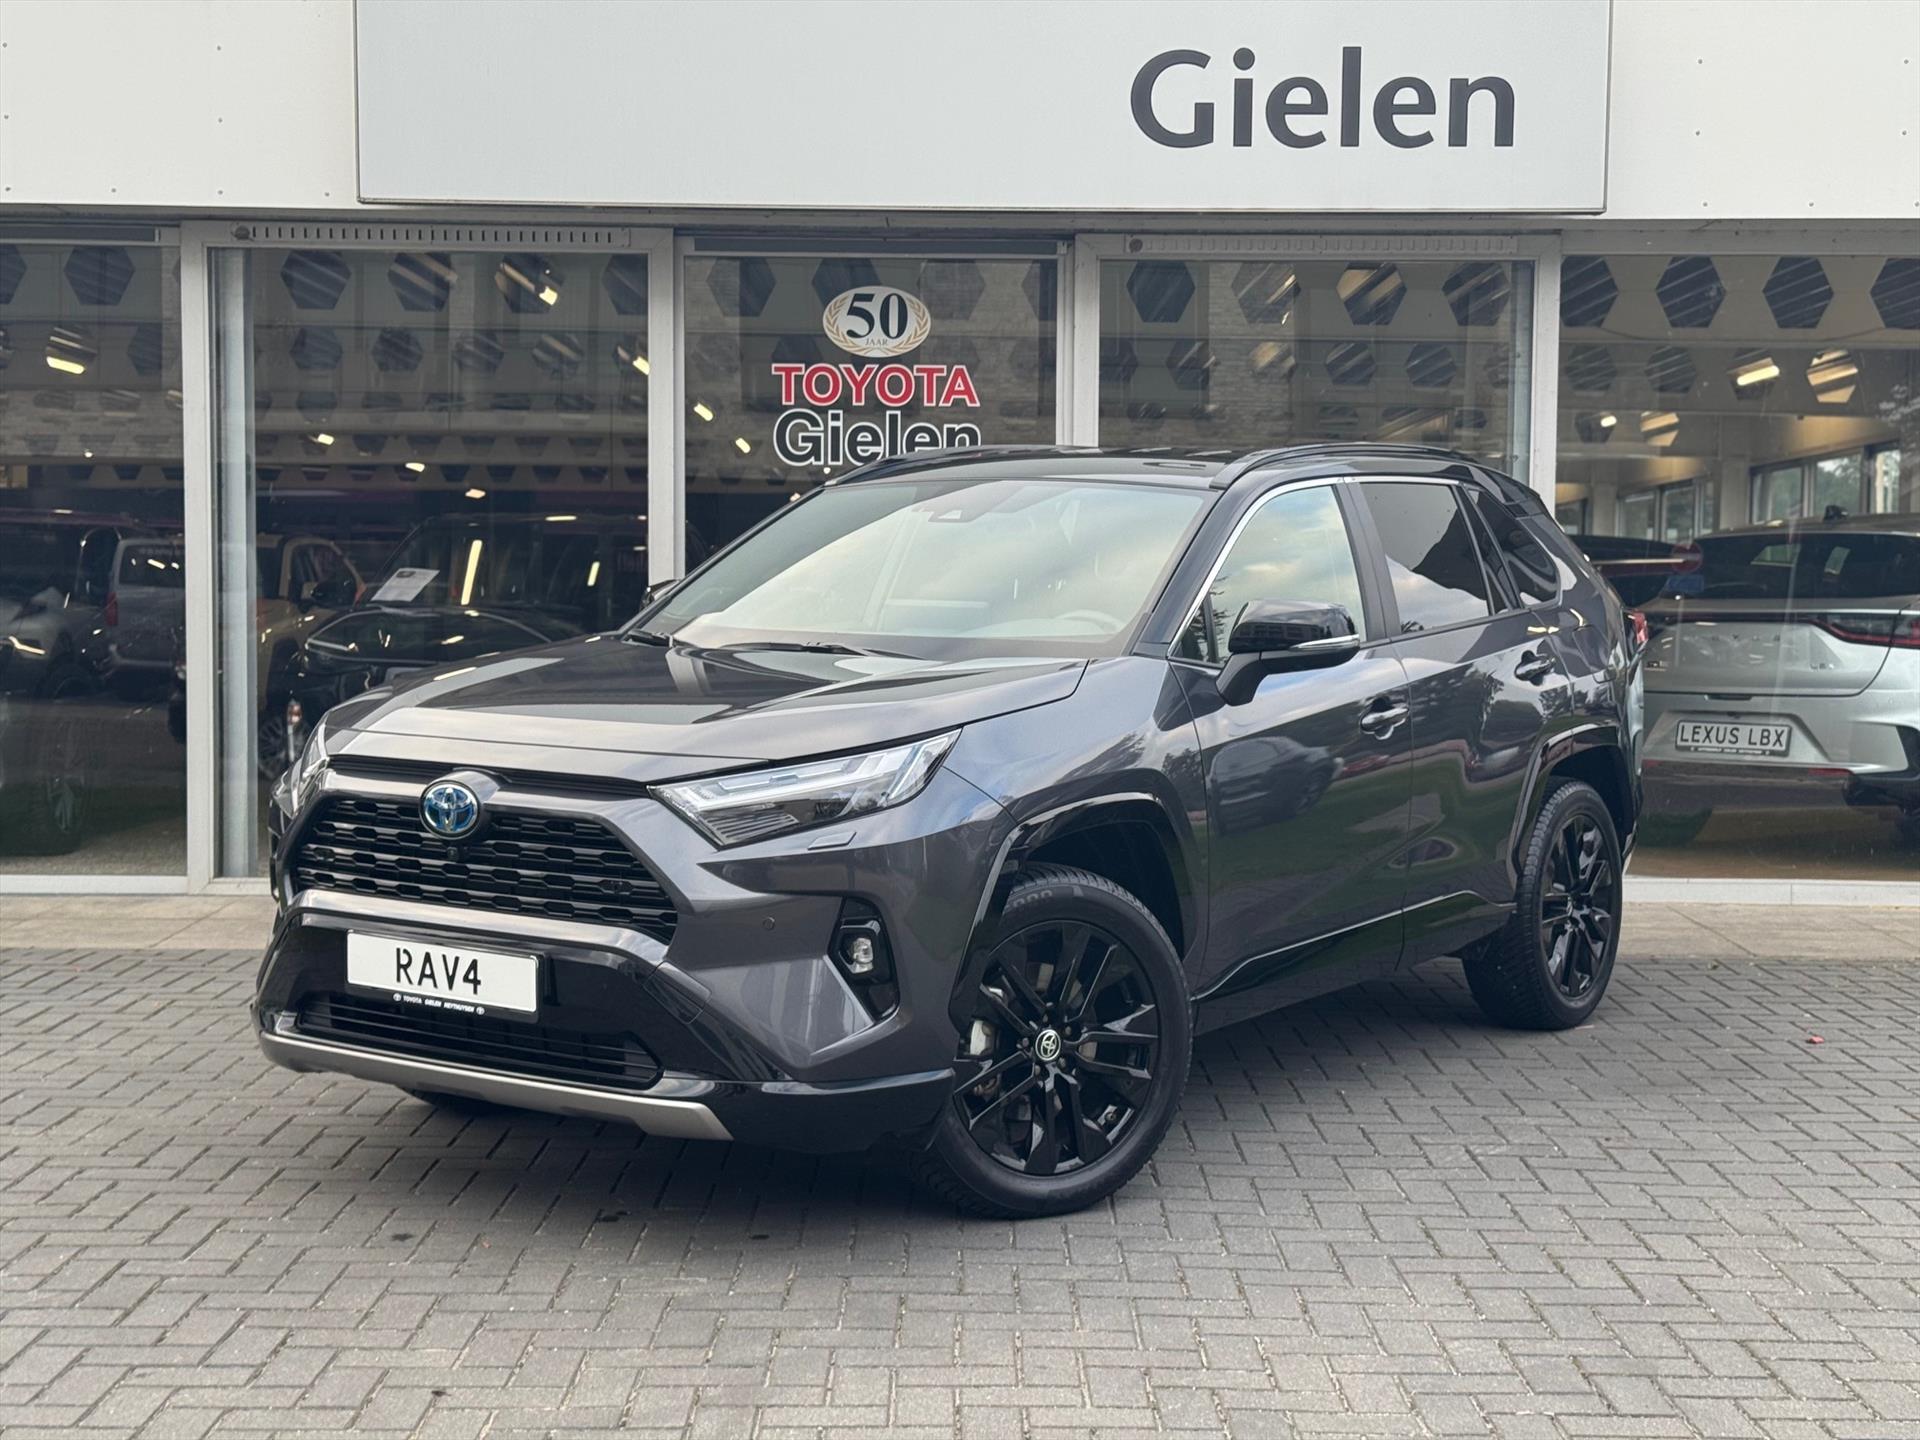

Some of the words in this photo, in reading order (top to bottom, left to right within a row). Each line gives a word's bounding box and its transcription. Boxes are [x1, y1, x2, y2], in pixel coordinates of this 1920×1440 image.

[1130, 46, 1515, 149] Gielen
[846, 292, 909, 340] 50
[865, 338, 889, 347] JAAR
[771, 363, 981, 407] TOYOTA
[773, 409, 981, 467] Gielen
[1680, 724, 1740, 745] LEXUS
[1748, 728, 1785, 748] LBX
[396, 947, 482, 995] RAV4
[403, 995, 422, 1004] TOYOTA
